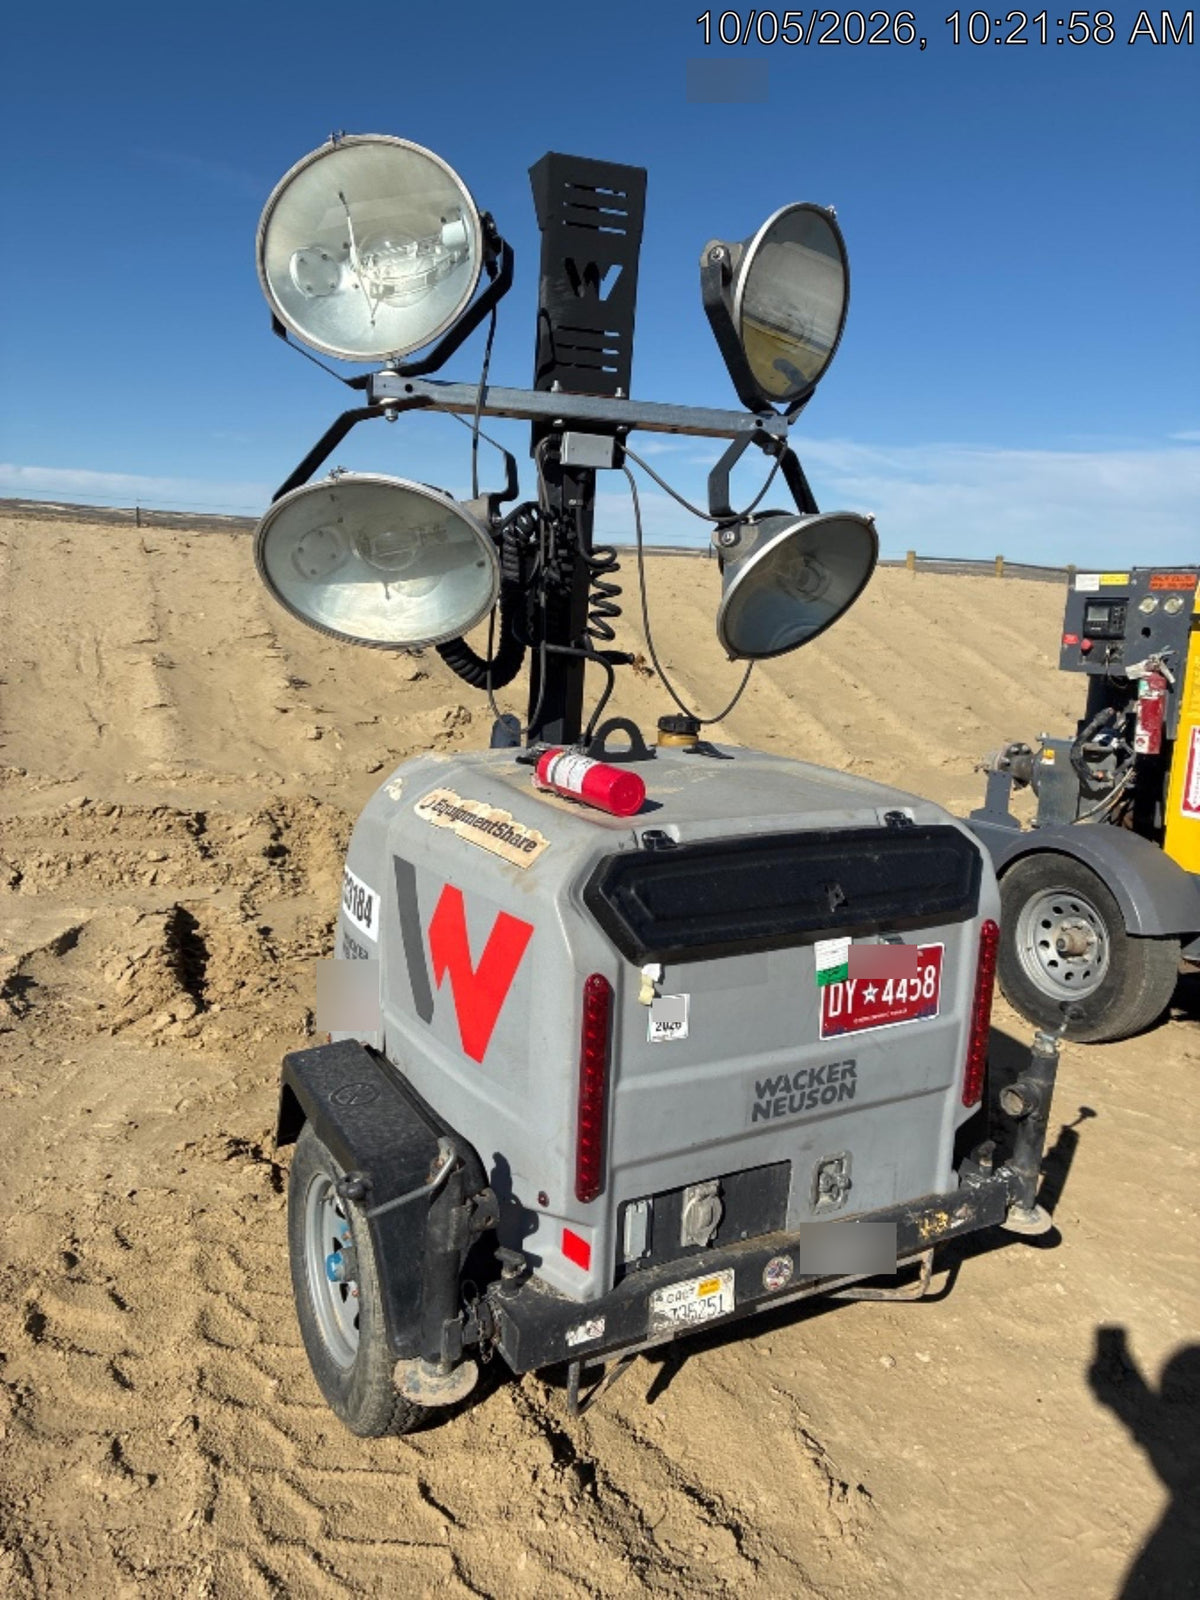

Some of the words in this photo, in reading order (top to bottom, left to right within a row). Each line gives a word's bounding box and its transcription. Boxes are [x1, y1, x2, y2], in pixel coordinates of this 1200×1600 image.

[432, 797, 538, 854] EquipmentShare
[751, 1079, 857, 1123] NEUSON
[755, 1059, 858, 1100] WACKER
